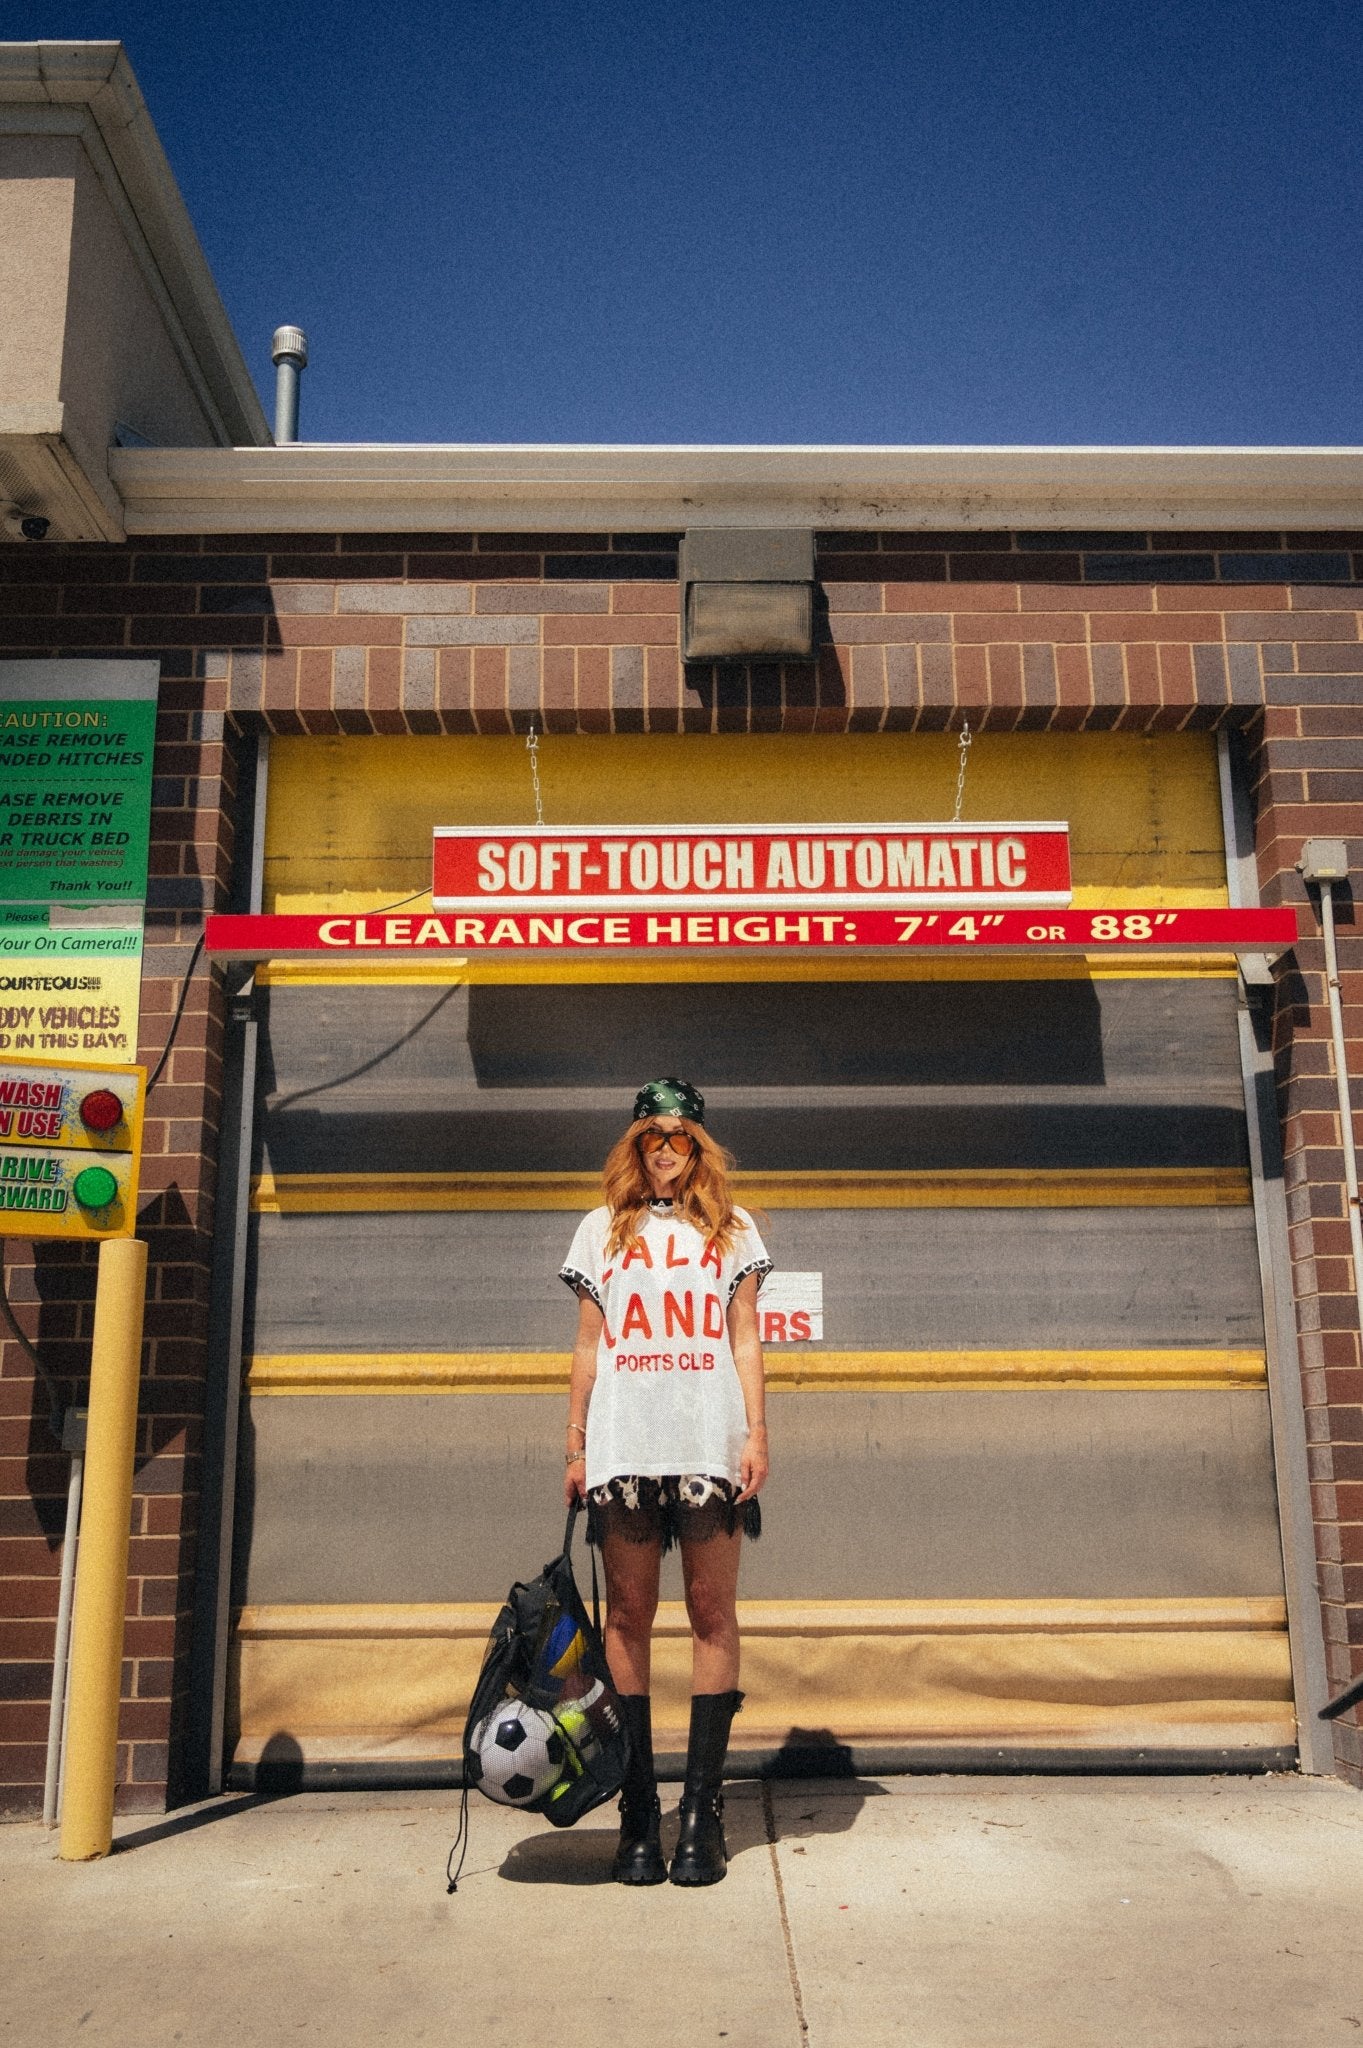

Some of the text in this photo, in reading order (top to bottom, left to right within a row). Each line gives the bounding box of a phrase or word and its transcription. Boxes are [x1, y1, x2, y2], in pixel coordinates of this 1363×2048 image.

[0, 712, 107, 728] AUTION:
[45, 733, 128, 747] REMOVE
[57, 752, 144, 766] HITCHES
[41, 792, 124, 806] REMOVE
[8, 812, 113, 826] DEBRIS IN
[20, 832, 87, 846] TRUCK
[91, 832, 130, 846] BED
[16, 848, 58, 859] damage
[61, 849, 85, 859] your
[88, 848, 126, 857] vehicle
[16, 861, 52, 870] person
[55, 860, 77, 868] that
[80, 859, 124, 869] washes)
[477, 838, 1027, 892] SOFT-TOUCH AUTOMATIC
[49, 881, 133, 892] Thank You!!
[5, 912, 40, 922] Please
[318, 917, 631, 946] CLEARANCE
[646, 915, 857, 944] HEIGHT:
[1026, 925, 1066, 941] OR
[35, 936, 57, 950] On
[61, 936, 138, 950] Camera!!!
[39, 1005, 120, 1030] VEHICLES
[16, 1033, 35, 1049] IN
[39, 1033, 79, 1049] THIS
[82, 1033, 127, 1049] BAY!
[0, 1081, 62, 1109] WASH
[17, 1111, 61, 1138] USE
[0, 1156, 58, 1182] RIVE
[756, 1311, 812, 1342] RS
[615, 1353, 675, 1372] PORTS
